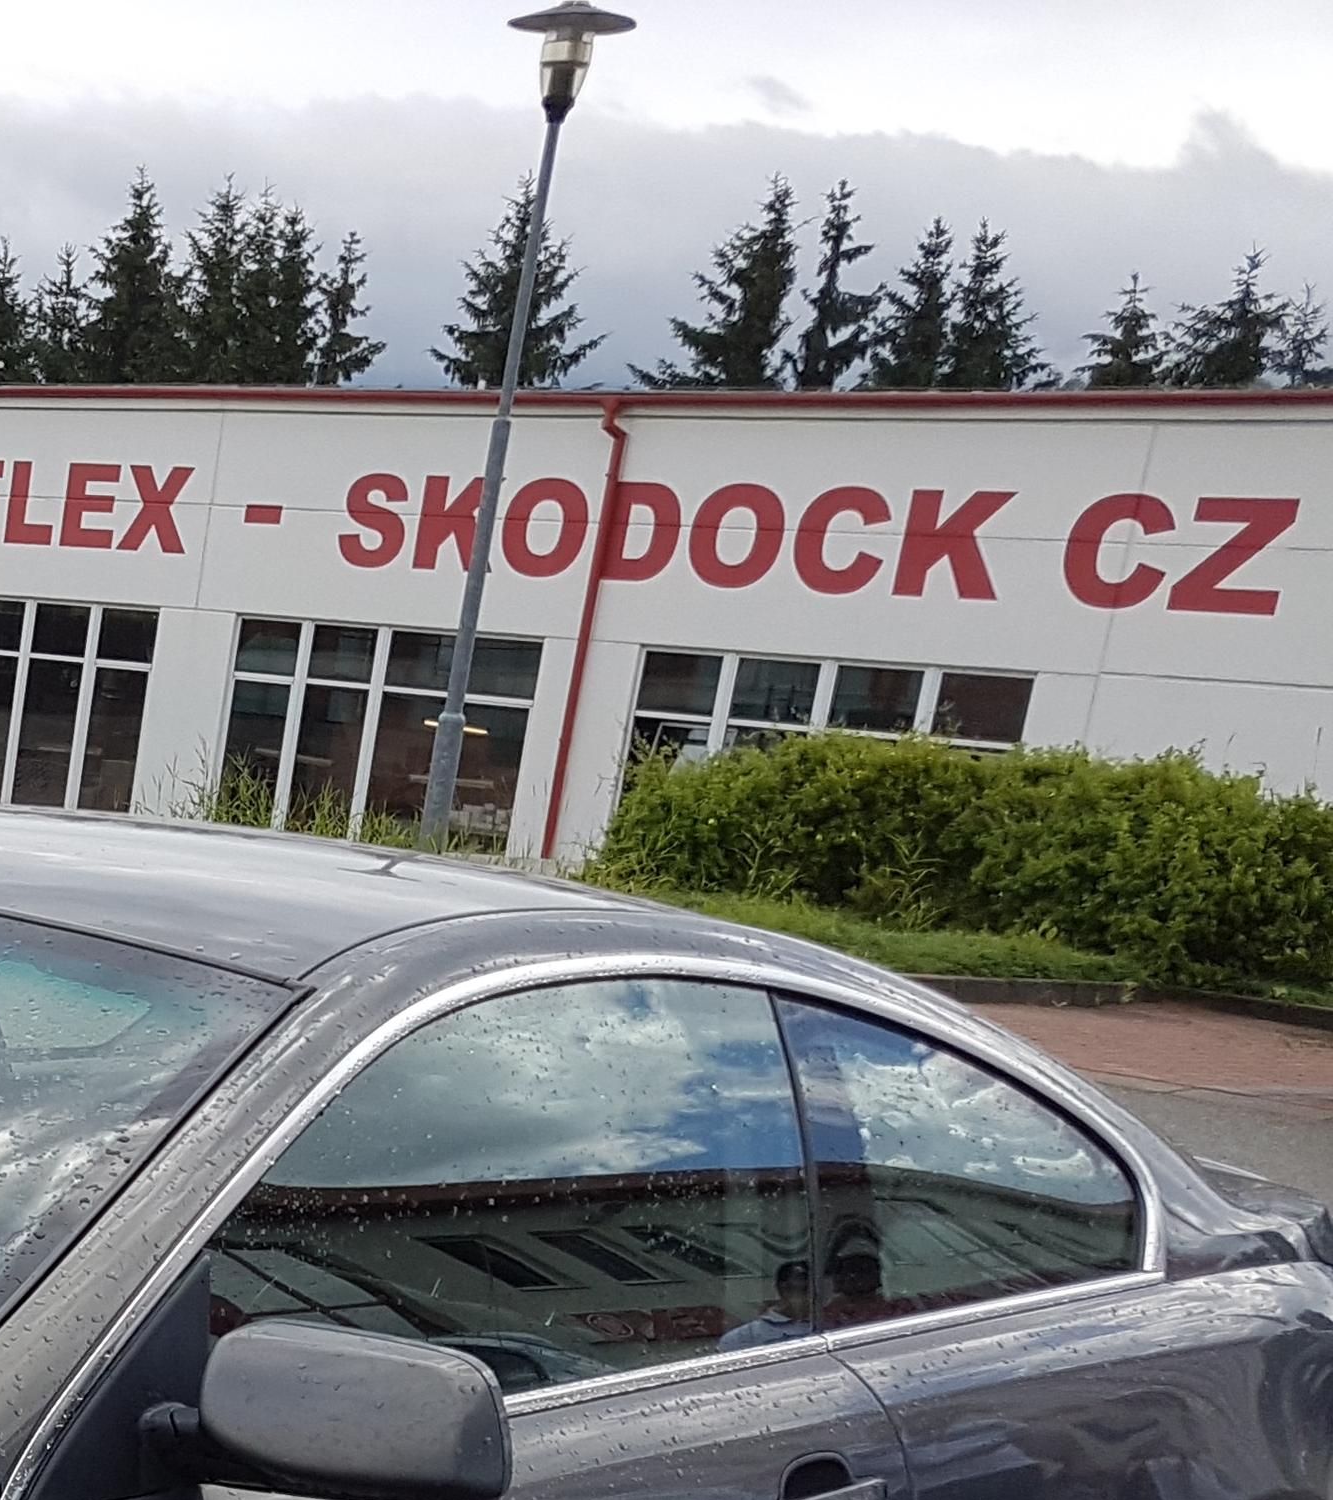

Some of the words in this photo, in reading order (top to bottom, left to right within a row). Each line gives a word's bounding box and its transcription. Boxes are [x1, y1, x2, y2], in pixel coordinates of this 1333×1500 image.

[244, 504, 283, 526] -
[338, 473, 1018, 601] SKODOCK
[1064, 493, 1301, 616] CZ
